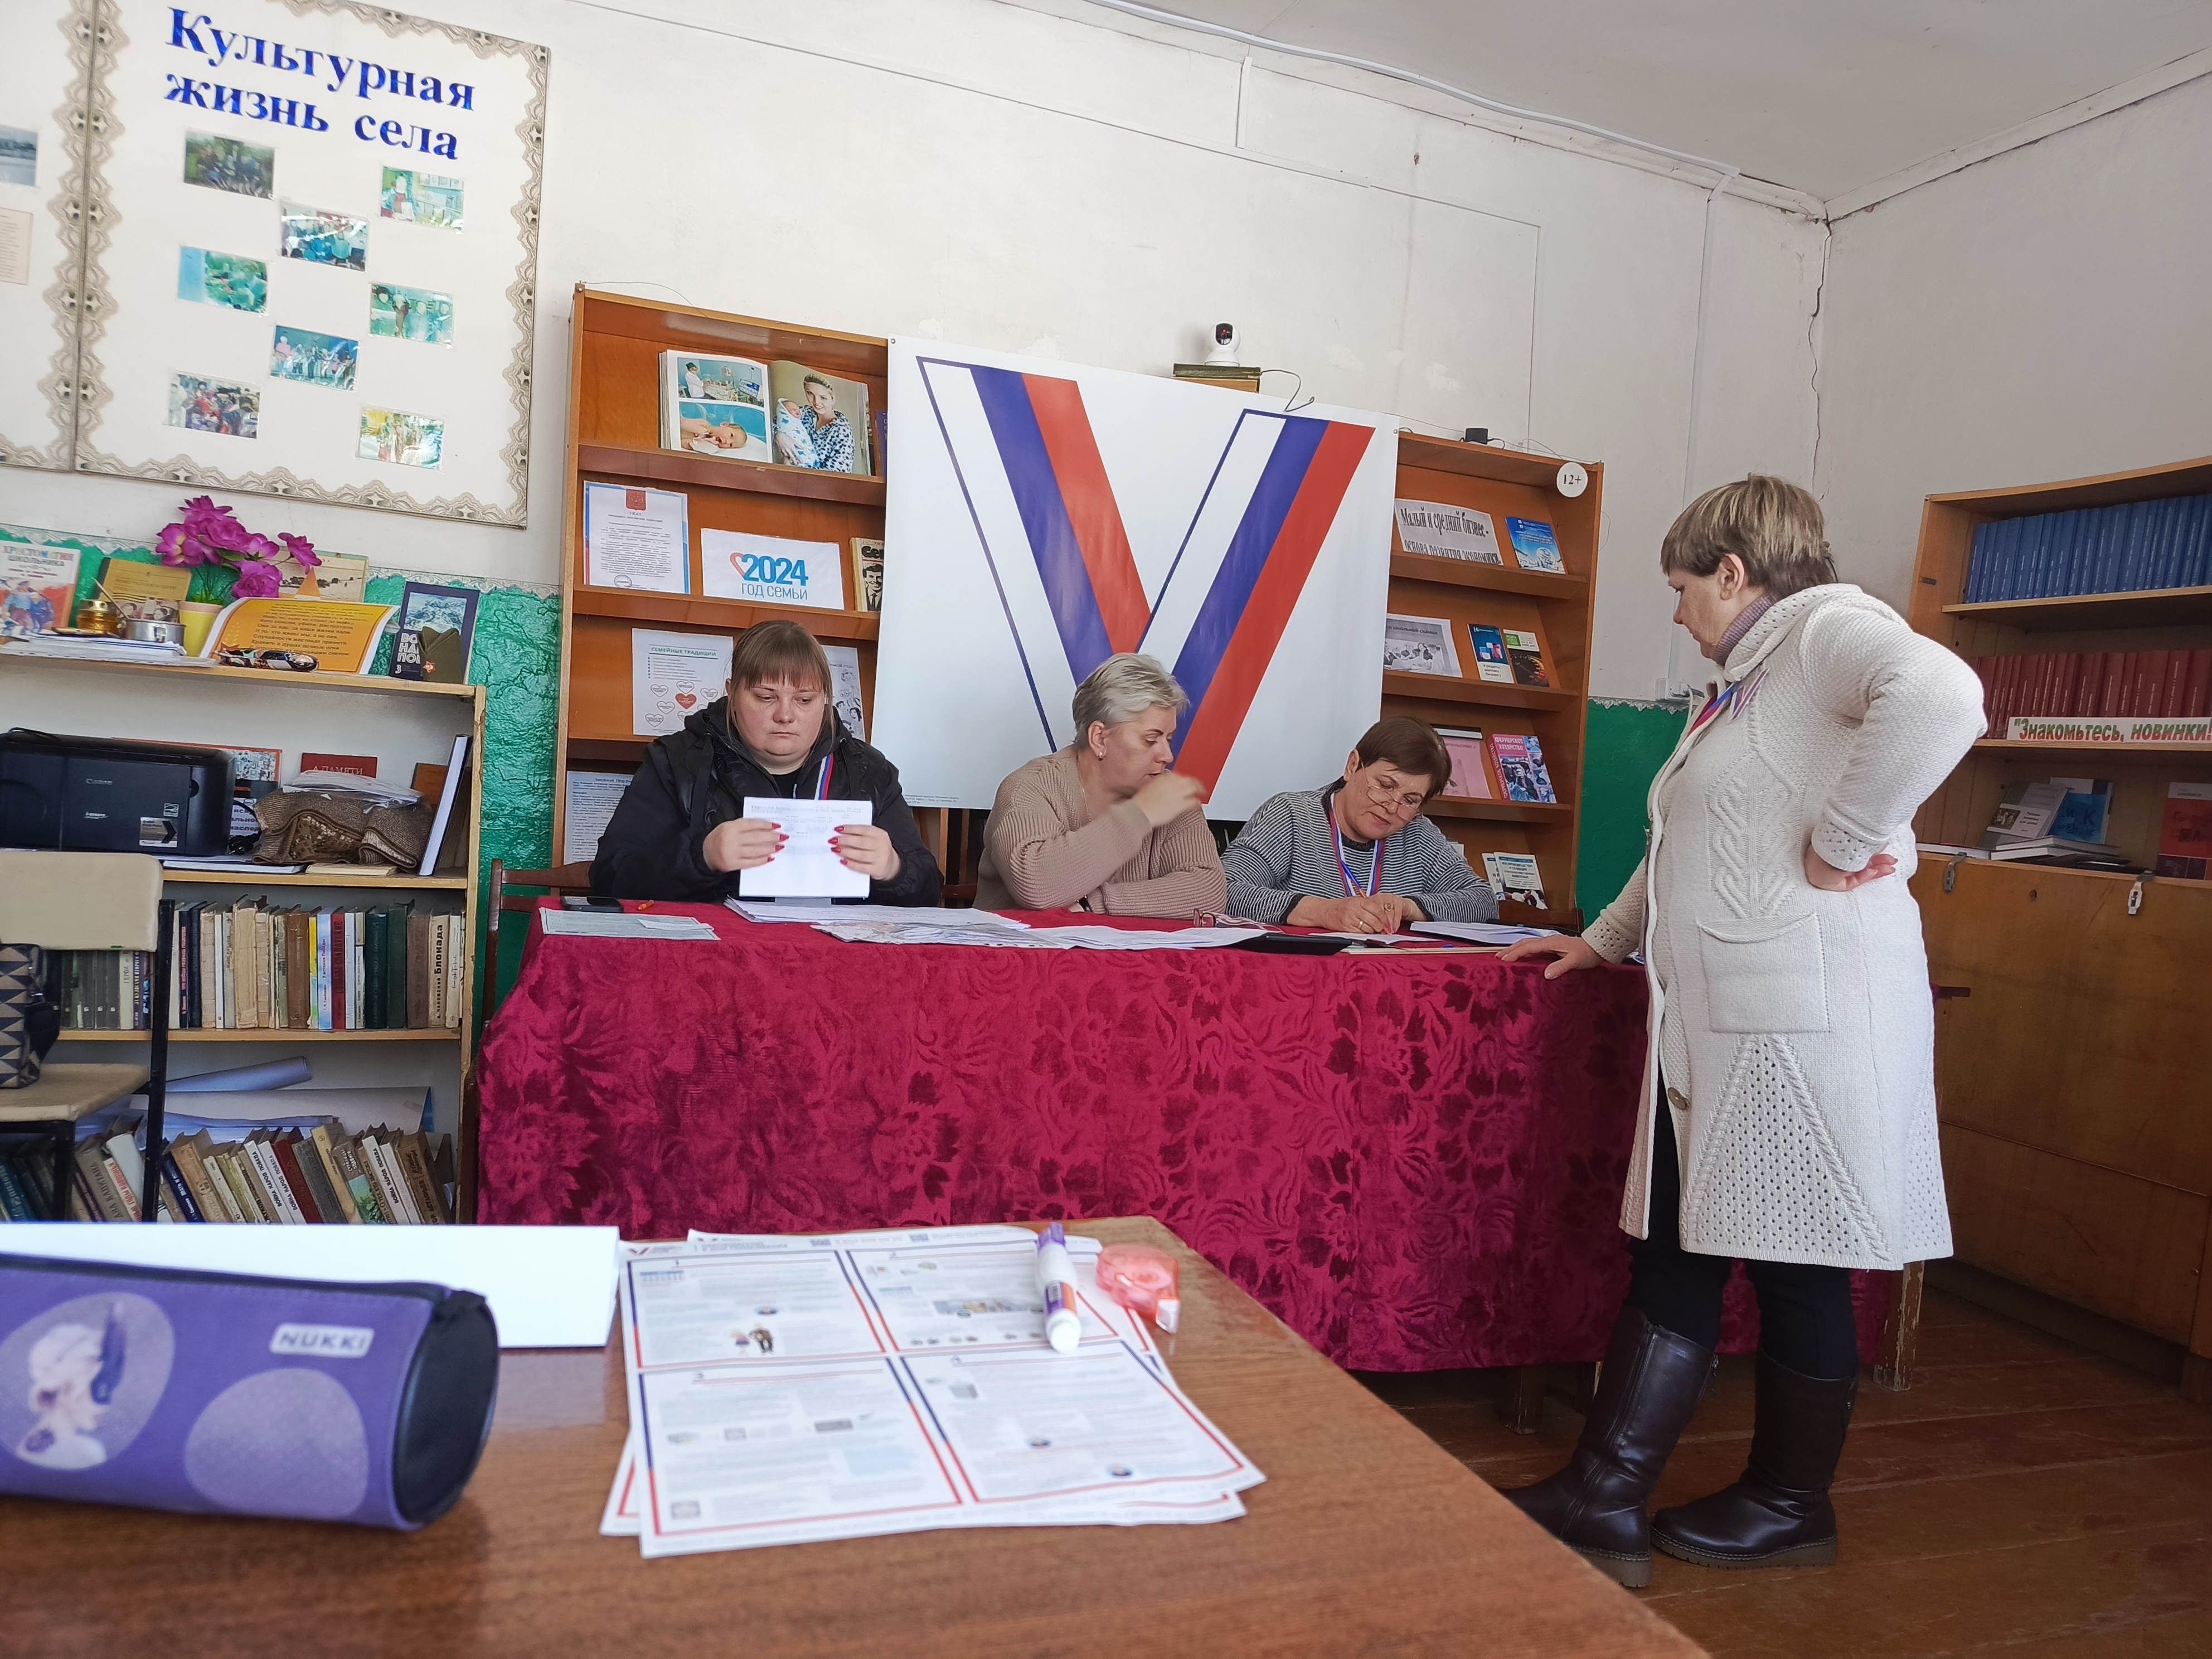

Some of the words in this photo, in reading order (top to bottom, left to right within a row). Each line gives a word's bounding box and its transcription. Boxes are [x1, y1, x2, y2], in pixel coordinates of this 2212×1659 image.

[166, 7, 476, 111] Культурная
[163, 74, 329, 133] жизнь
[353, 110, 458, 161] села
[1563, 474, 1582, 485] 12+
[1400, 506, 1427, 527] Малый
[1427, 513, 1433, 528] и
[1433, 511, 1462, 535] средний
[1462, 512, 1486, 537] бизнес
[741, 554, 809, 586] 2024
[741, 583, 764, 598] ГОД
[2014, 718, 2124, 742] "Знакомьтесь,
[434, 924, 443, 974] Блокада
[251, 1151, 265, 1171] ПОБЕДА
[268, 1154, 280, 1175] ПОБЕДА
[372, 1148, 384, 1168] ПОБЕДА
[90, 1162, 114, 1202] КАПИТАНА
[261, 1171, 275, 1191] НАРОД
[278, 1175, 290, 1194] НАРОД
[381, 1169, 392, 1187] НАРОД
[271, 1191, 283, 1207] ВОЙНА
[287, 1195, 298, 1211] ВОЙНА
[389, 1188, 399, 1204] ВОЙНА
[419, 1179, 434, 1212] АСТАФЬЕВ
